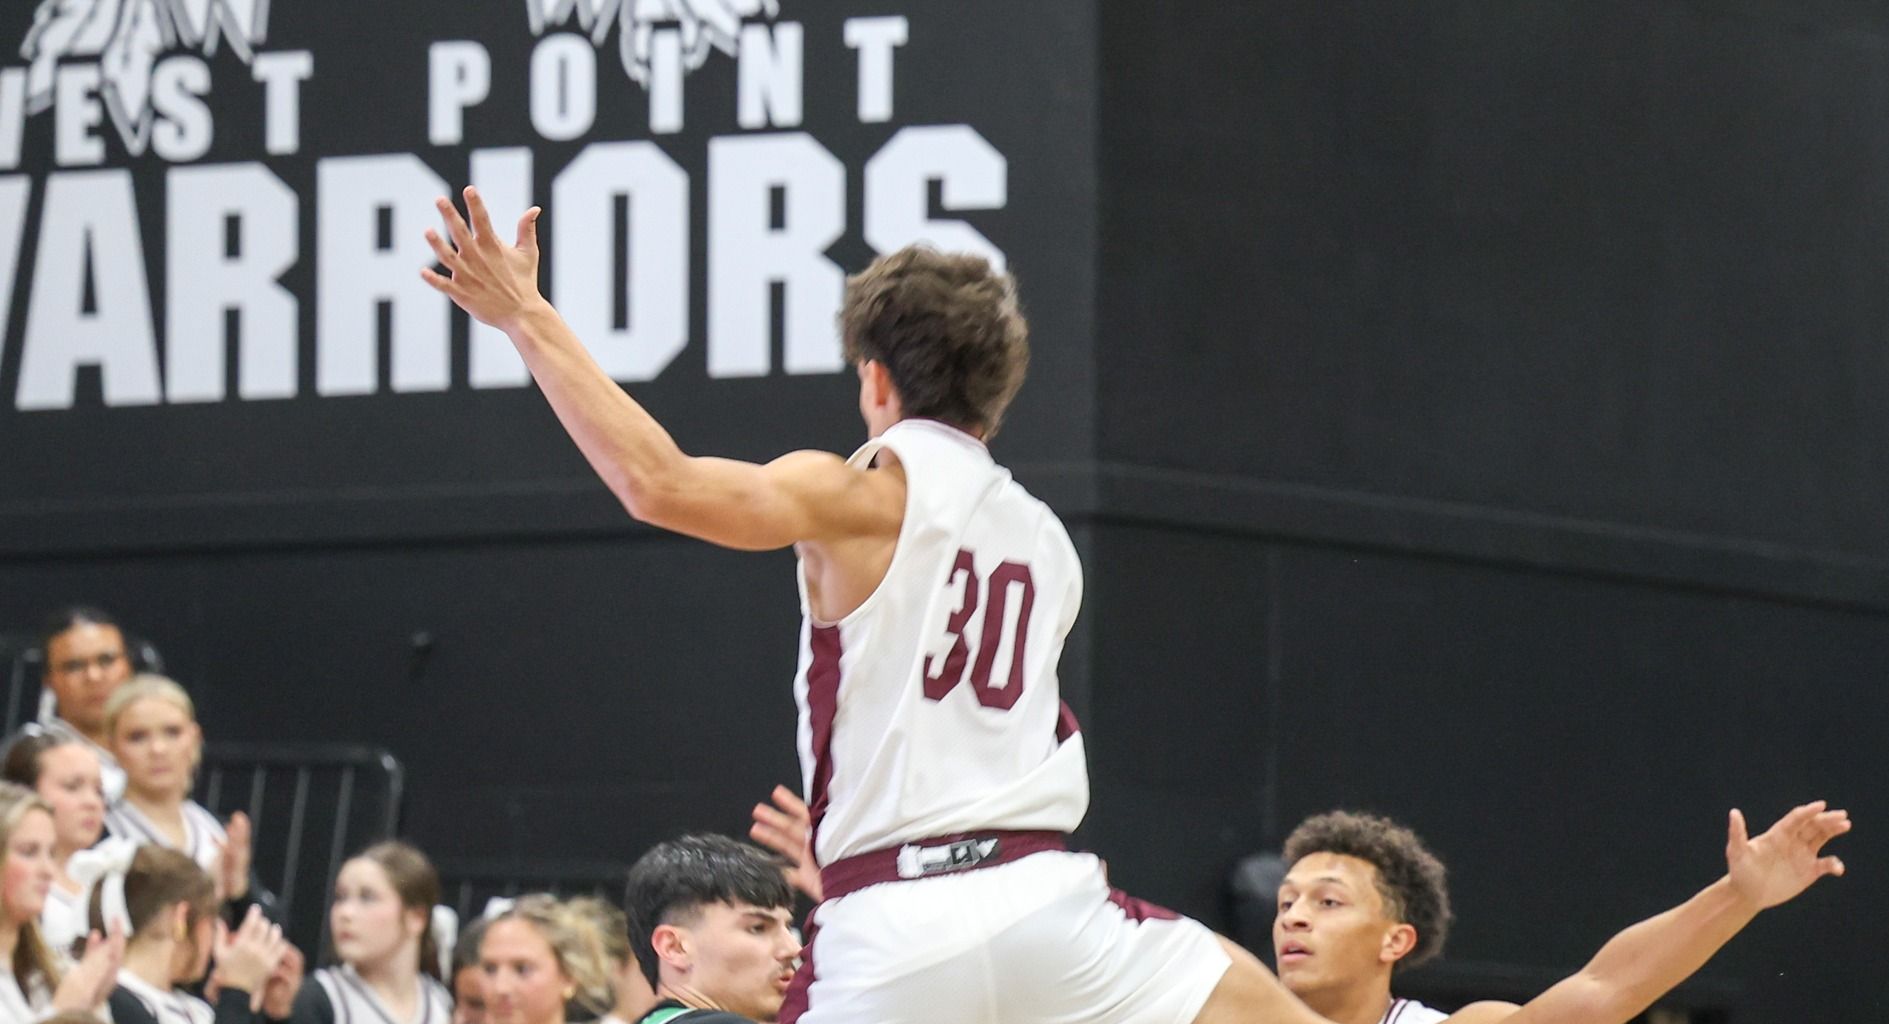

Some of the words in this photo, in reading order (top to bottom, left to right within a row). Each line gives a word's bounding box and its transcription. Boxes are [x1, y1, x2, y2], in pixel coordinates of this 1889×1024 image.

[0, 50, 314, 169] EST
[428, 16, 909, 146] POINT
[0, 124, 1008, 411] ARRIORS
[923, 548, 1035, 712] 30
